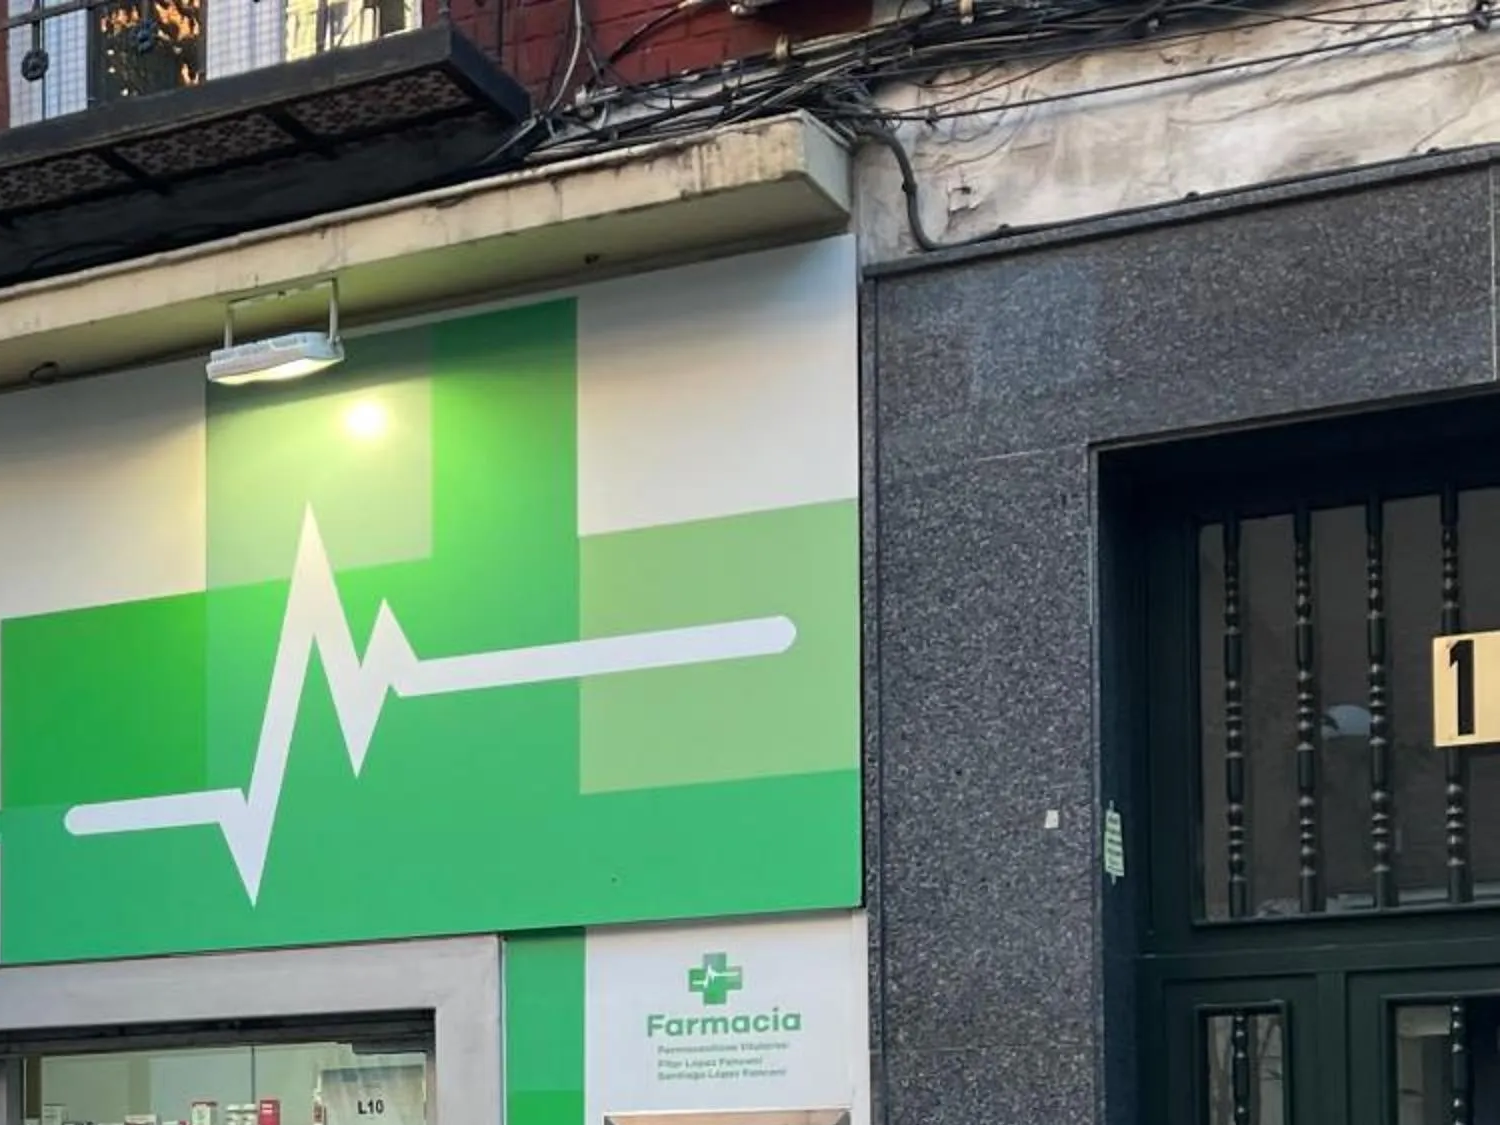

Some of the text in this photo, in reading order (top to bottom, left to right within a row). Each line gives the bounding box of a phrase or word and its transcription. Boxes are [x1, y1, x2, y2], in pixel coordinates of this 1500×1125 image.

[1449, 639, 1475, 736] 1
[647, 1006, 802, 1037] Farmacia
[357, 1099, 385, 1115] L10
